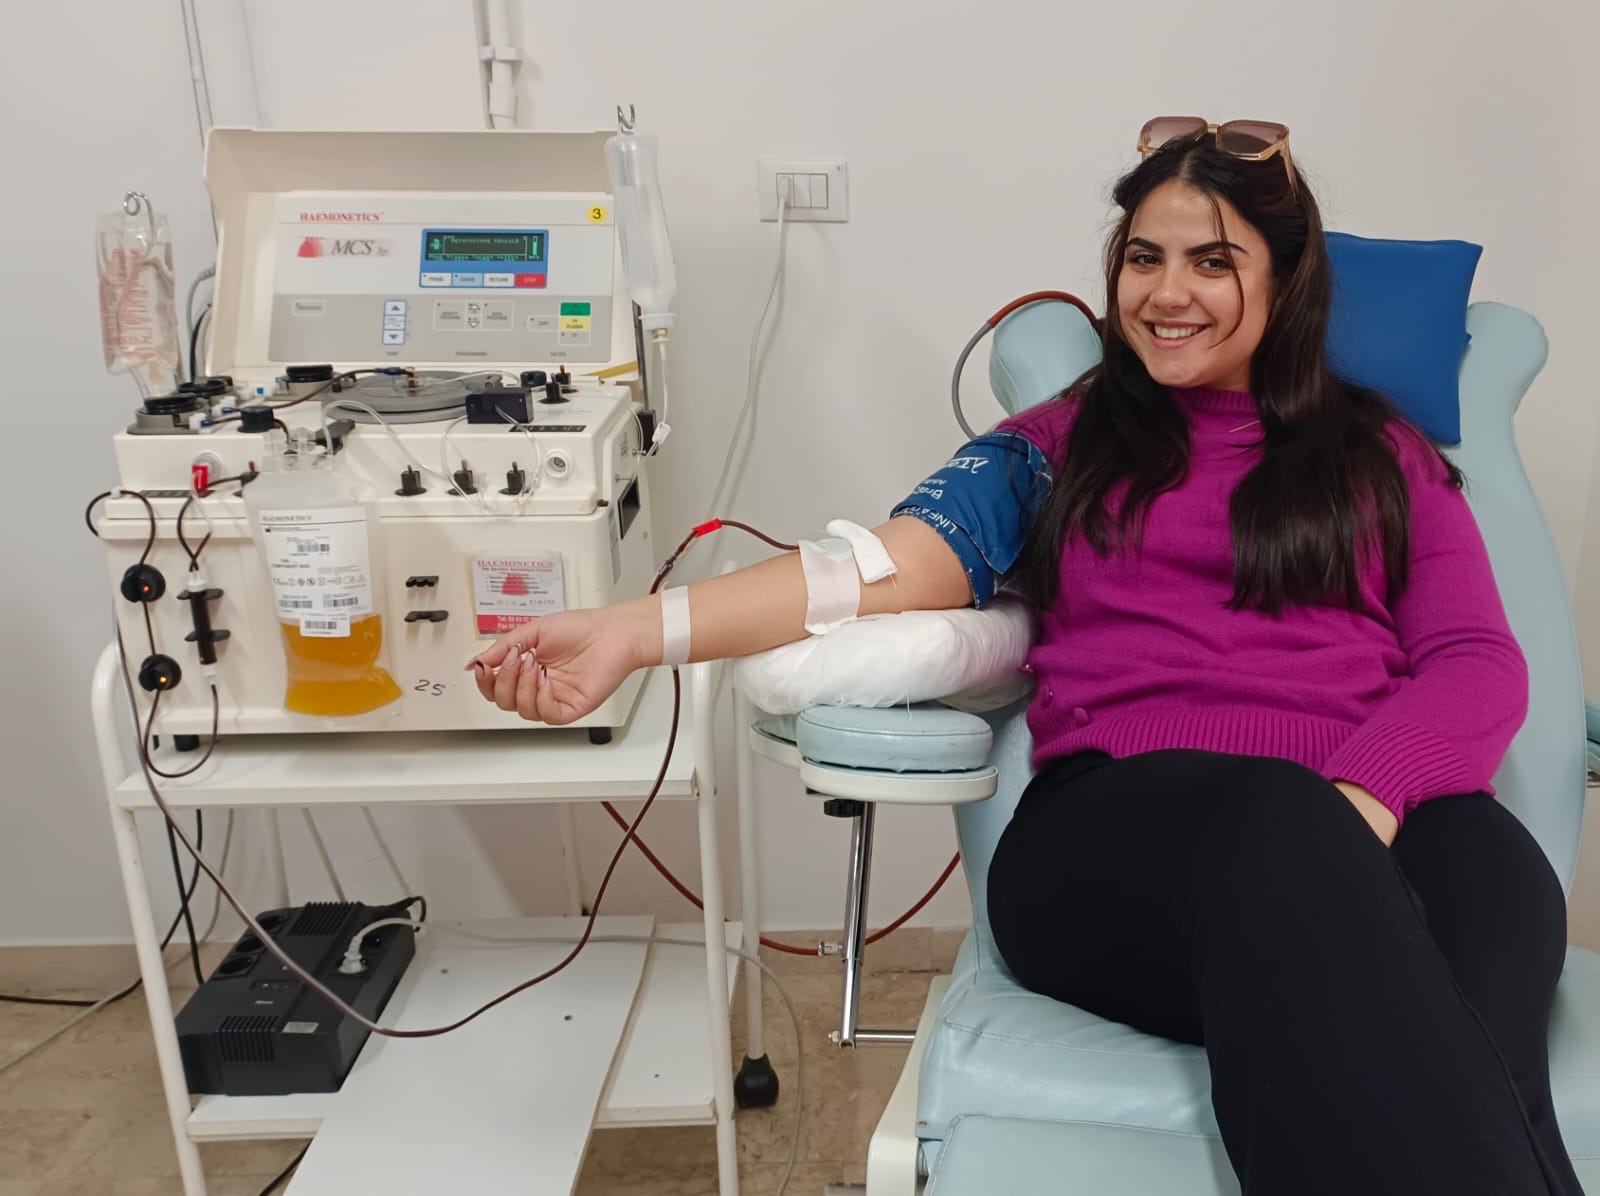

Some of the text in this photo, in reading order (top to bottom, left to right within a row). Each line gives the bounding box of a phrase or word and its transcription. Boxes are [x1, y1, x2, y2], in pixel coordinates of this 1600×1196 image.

[299, 212, 380, 222] HAEMONETICS
[592, 207, 602, 220] 3
[477, 559, 554, 568] HAEMONETICS
